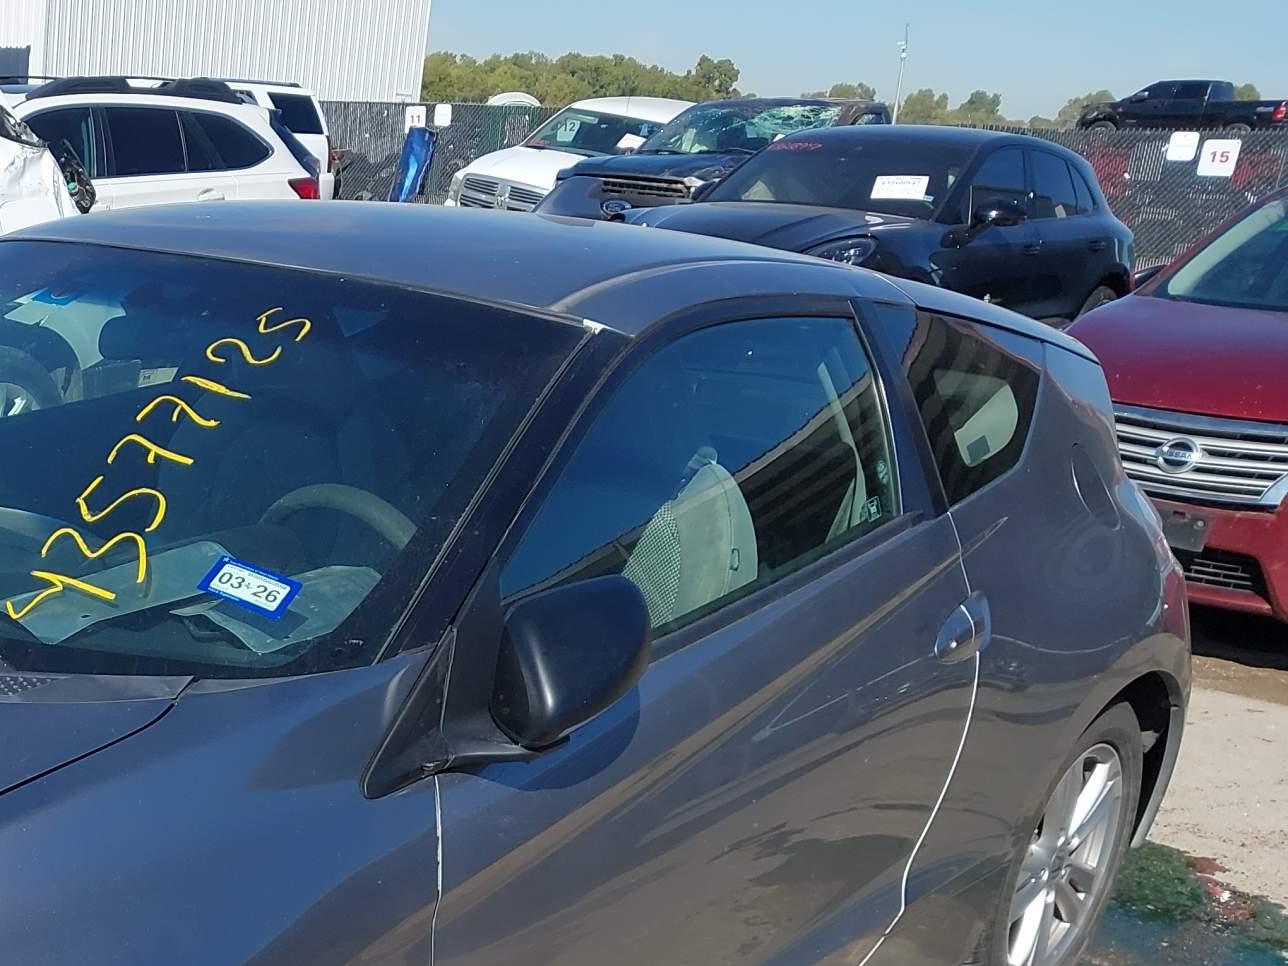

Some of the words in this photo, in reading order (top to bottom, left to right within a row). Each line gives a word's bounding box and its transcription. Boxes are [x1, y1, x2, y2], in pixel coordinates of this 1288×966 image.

[410, 114, 421, 124] 11
[1210, 150, 1231, 164] 15
[6, 306, 312, 620] 43577125
[218, 571, 245, 590] 03
[252, 584, 281, 603] 26
